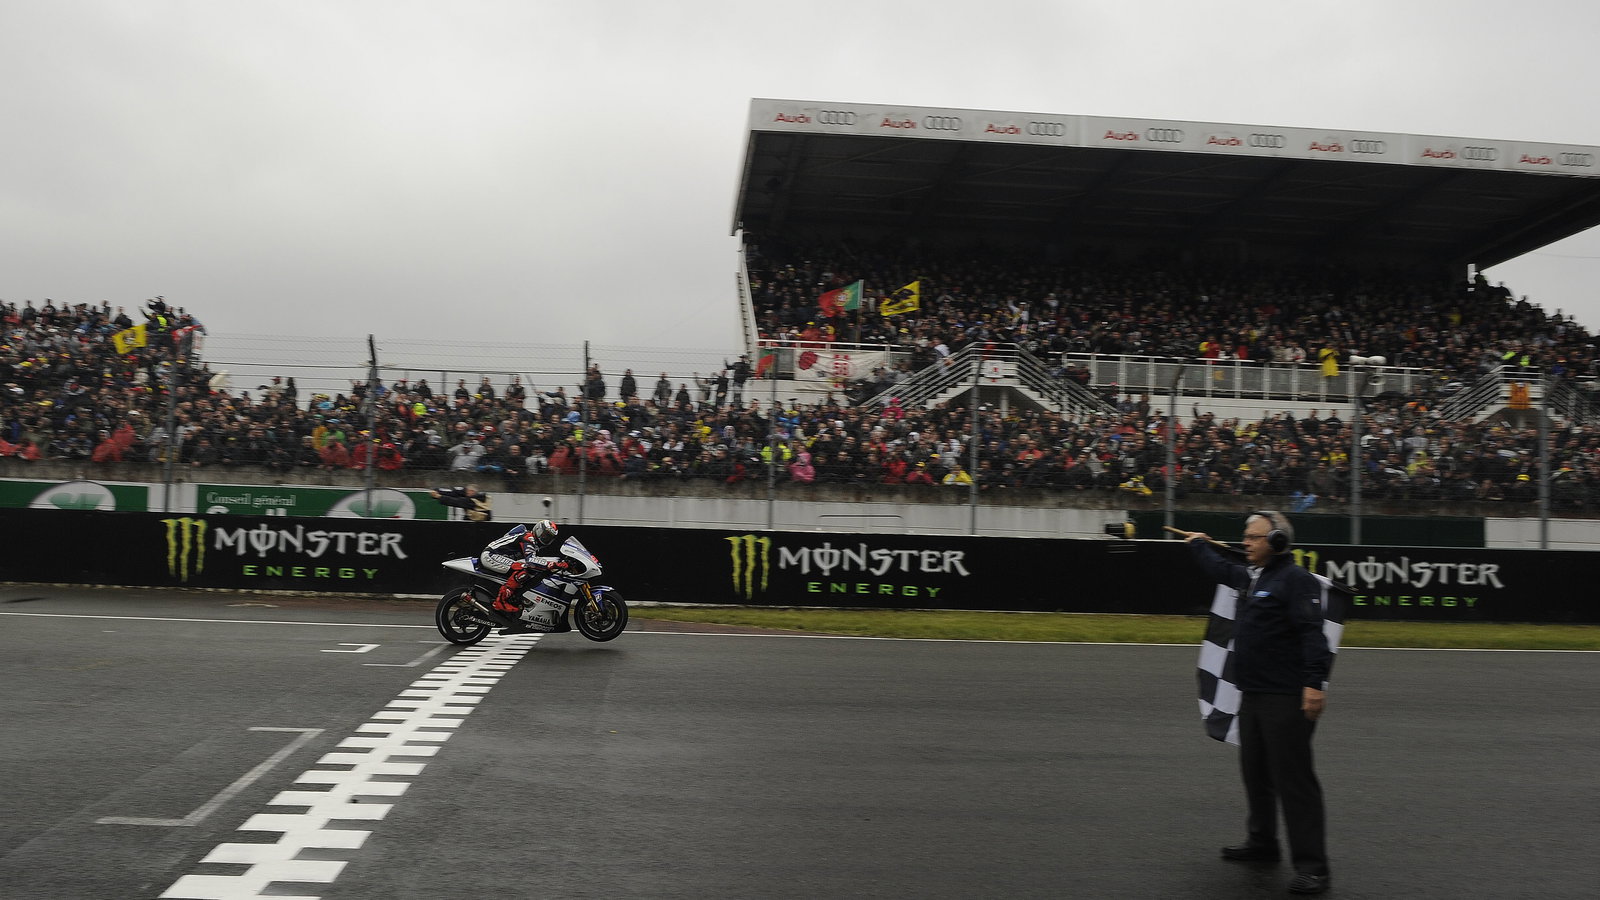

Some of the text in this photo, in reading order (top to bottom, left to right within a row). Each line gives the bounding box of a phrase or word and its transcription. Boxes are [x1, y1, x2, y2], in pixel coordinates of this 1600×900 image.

[774, 112, 812, 124] Audi
[879, 118, 917, 129] Audi
[984, 123, 1022, 135] Audi
[1103, 130, 1140, 141] Audi
[1206, 135, 1243, 147] Audi
[1309, 142, 1344, 152] Audi
[1420, 148, 1457, 160] Audi
[1518, 154, 1553, 165] Audi
[206, 492, 251, 505] Conseil
[214, 523, 408, 560] MONSTER
[778, 542, 971, 577] MONSTER
[243, 565, 379, 580] ENERGY
[1326, 556, 1505, 589] MONSTER
[807, 581, 942, 598] ENERGY
[540, 598, 563, 610] ENEOS
[1353, 595, 1478, 608] ENERGY
